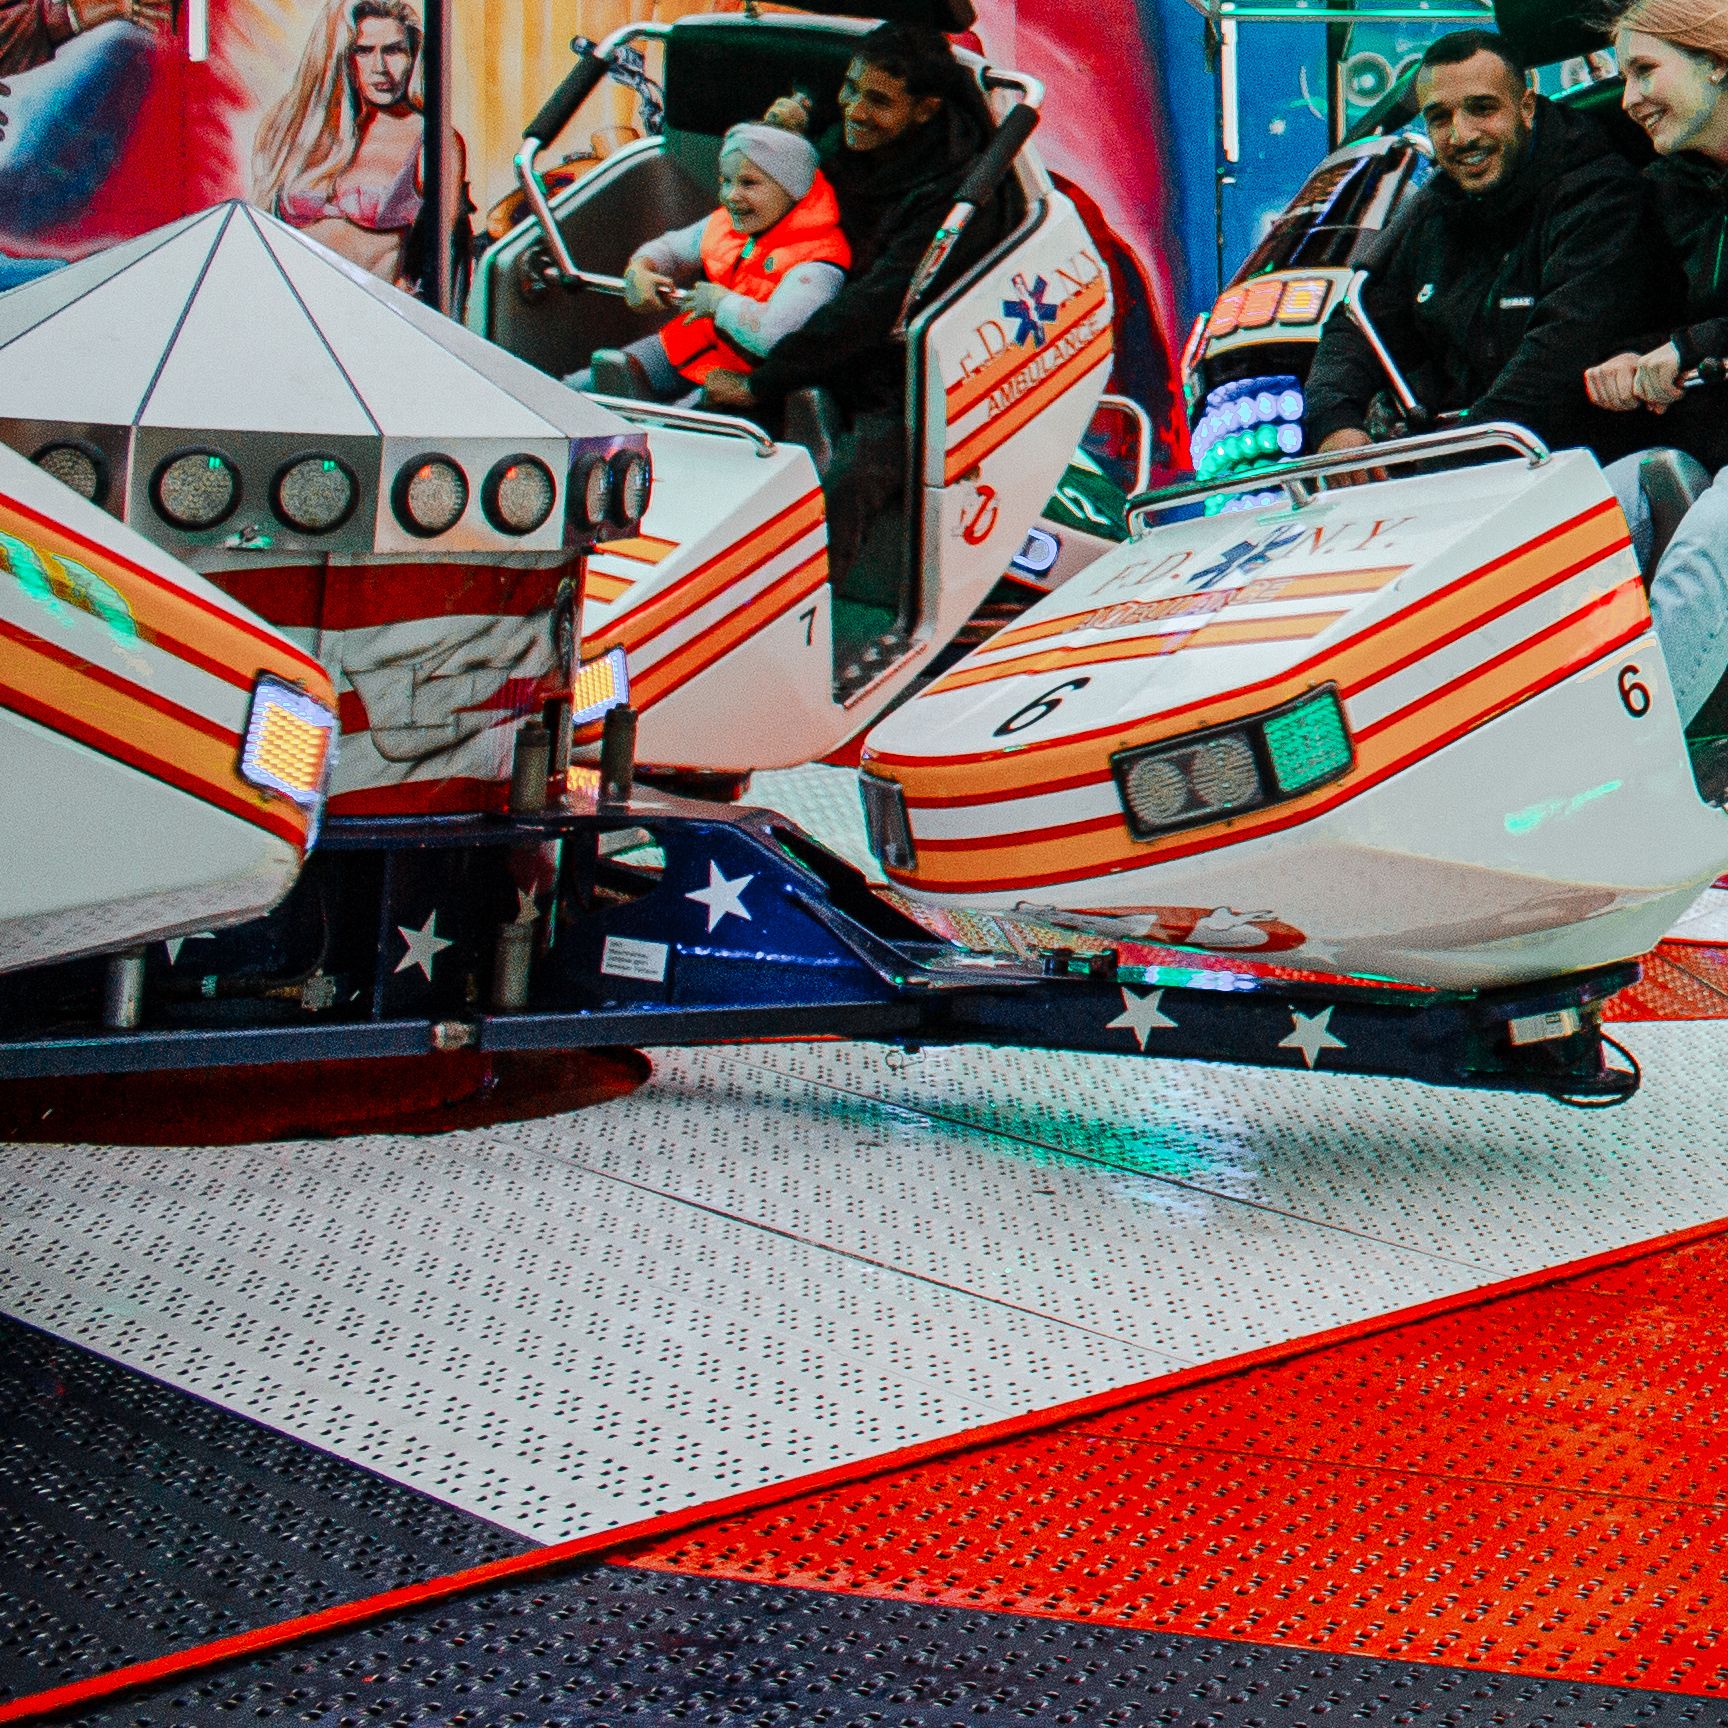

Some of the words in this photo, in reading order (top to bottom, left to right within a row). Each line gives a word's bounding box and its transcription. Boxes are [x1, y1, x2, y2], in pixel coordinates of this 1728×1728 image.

[800, 606, 817, 647] 7
[993, 675, 1091, 738] 6
[1617, 664, 1652, 719] 6
